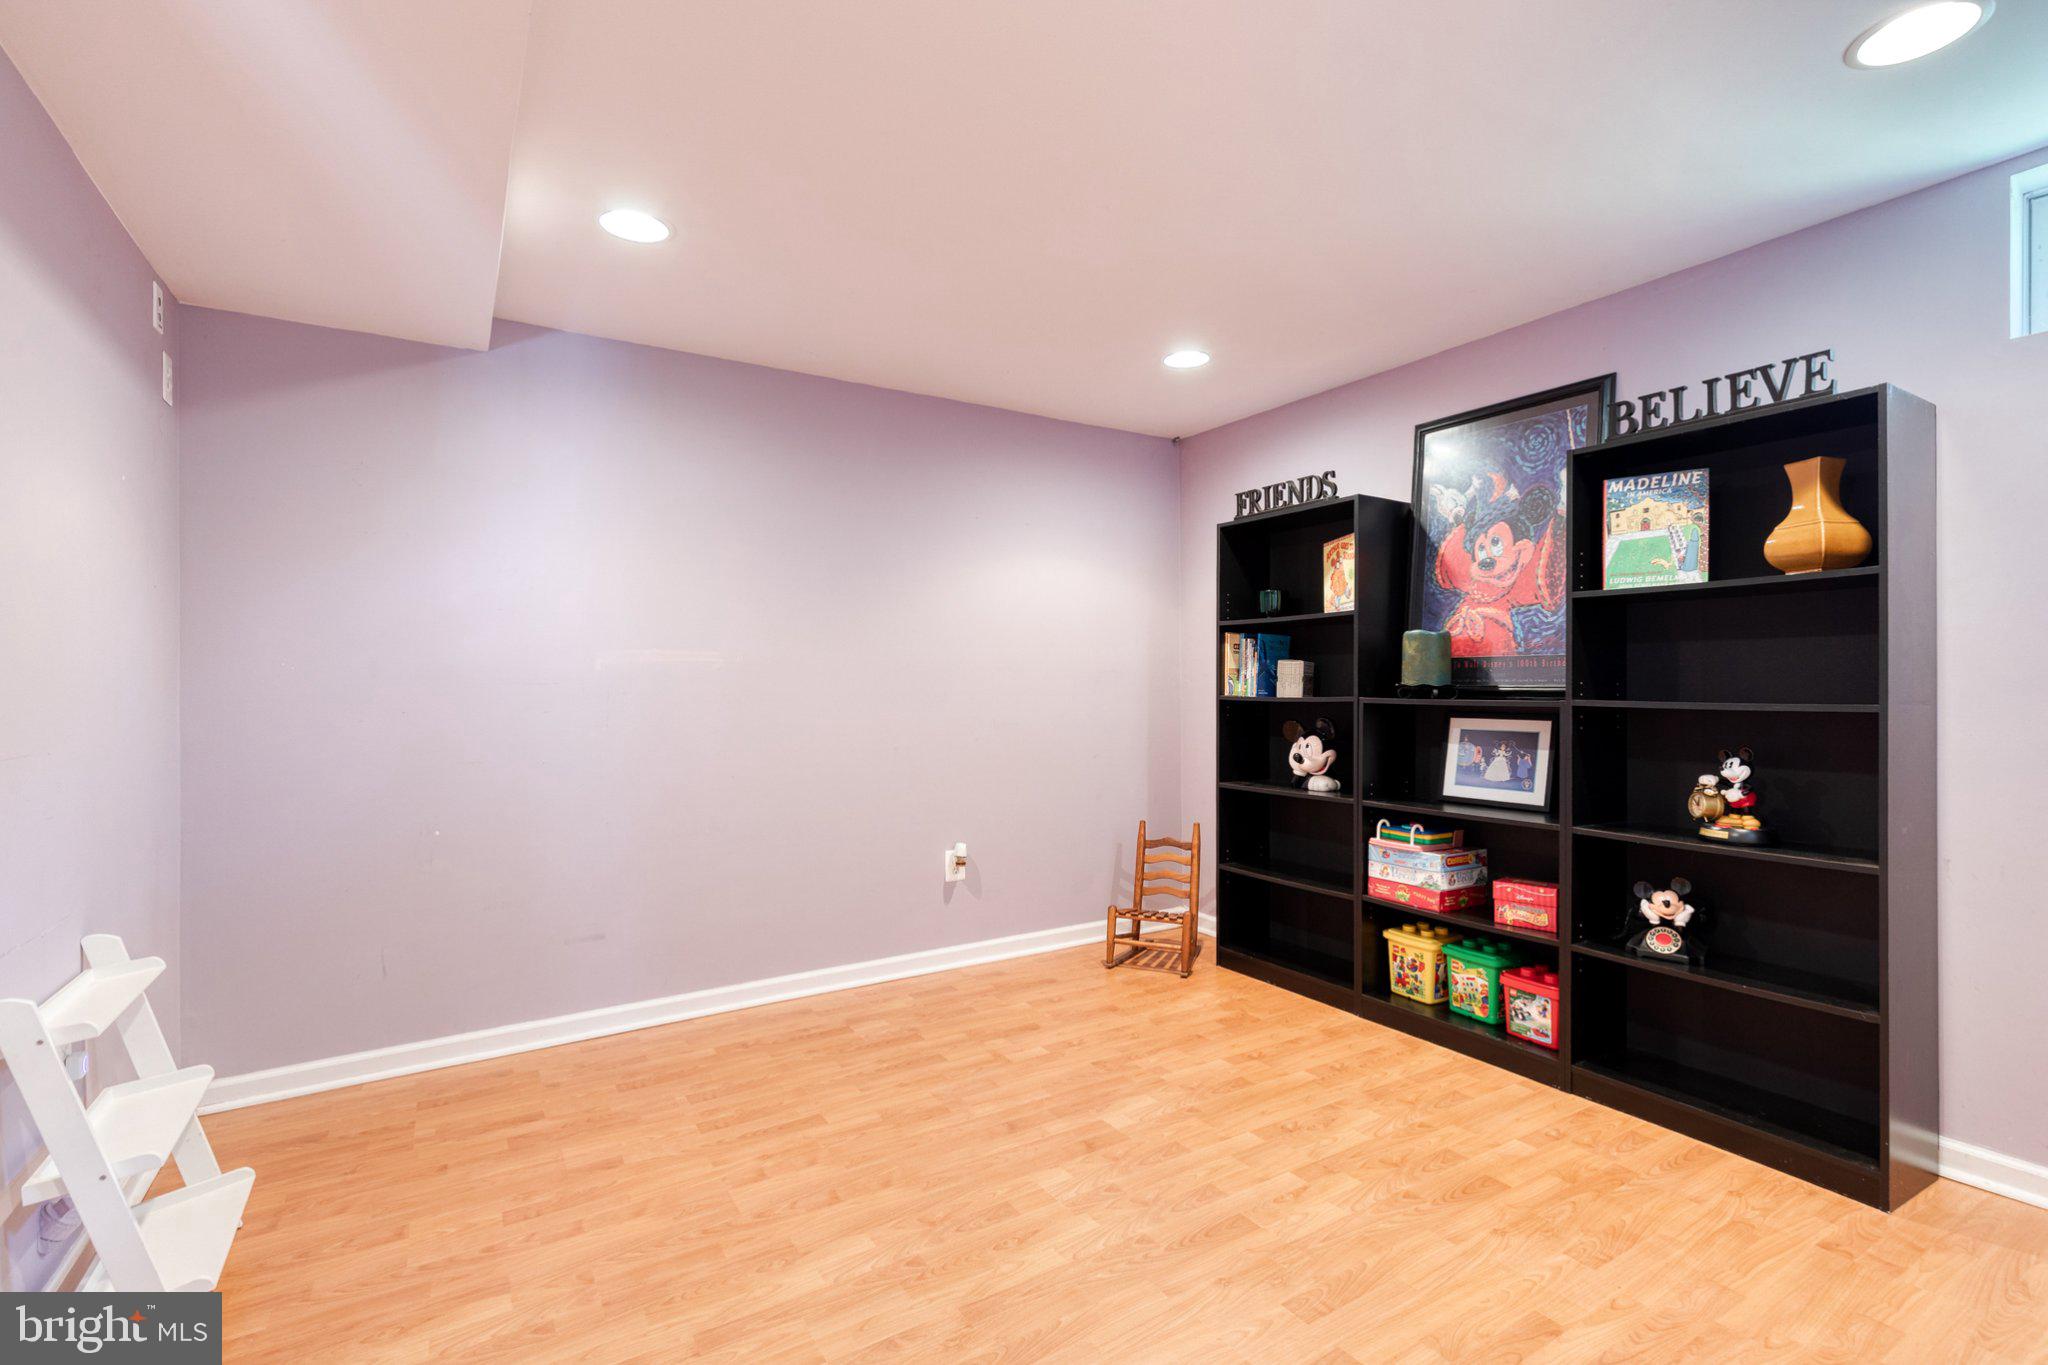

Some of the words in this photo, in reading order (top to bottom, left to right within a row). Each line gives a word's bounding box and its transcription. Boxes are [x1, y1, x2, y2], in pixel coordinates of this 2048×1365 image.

[1609, 349, 1835, 437] BELIEVE
[1608, 471, 1702, 493] MADELINE
[1638, 487, 1673, 497] AMERICA
[1234, 470, 1338, 519] FRIENDS
[1609, 576, 1642, 584] LUDWIG
